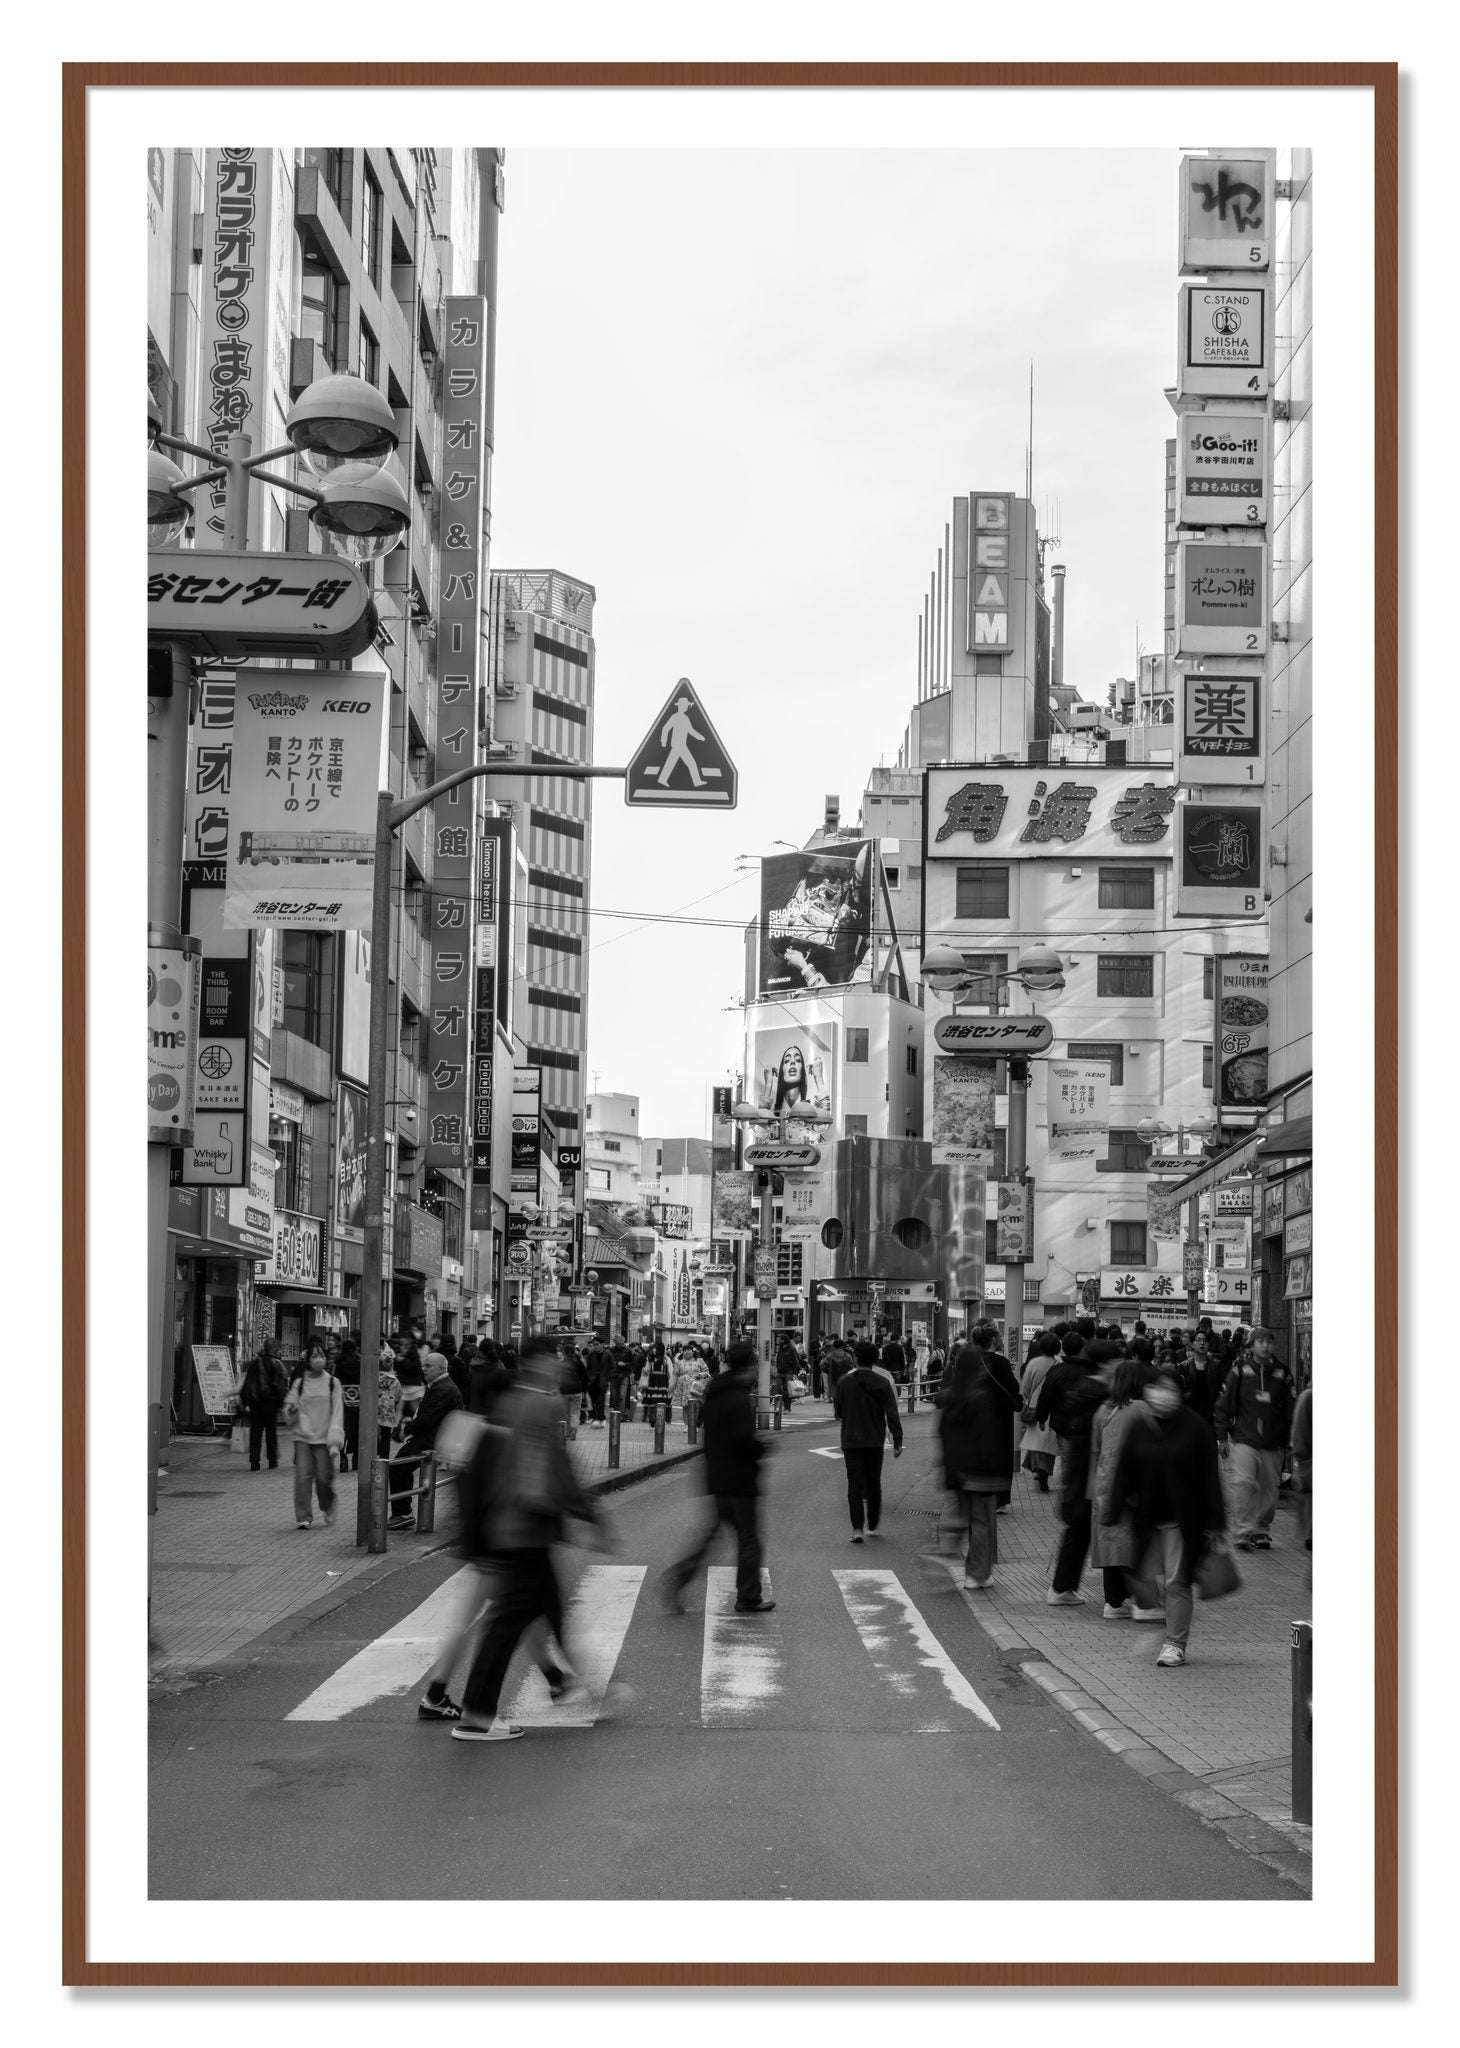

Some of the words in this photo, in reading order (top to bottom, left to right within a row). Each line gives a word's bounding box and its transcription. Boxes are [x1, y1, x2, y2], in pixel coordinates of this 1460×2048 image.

[215, 161, 256, 303] カラオケ
[1248, 247, 1262, 263] 5
[1203, 296, 1250, 306] C.STAND
[1203, 336, 1249, 348] SHISHA
[1203, 348, 1249, 357] CAFE&BAR
[1247, 376, 1260, 391] 4
[1202, 435, 1258, 453] Goo-it!
[1195, 455, 1255, 465] 渋谷宇田川町店
[1190, 481, 1259, 494] 全身もみほぐし
[1246, 504, 1259, 521] 3
[976, 498, 1010, 645] BEAM
[1191, 577, 1256, 597] ポムの樹
[1201, 600, 1248, 609] Pomme-no-ki
[1245, 634, 1258, 650] 2
[261, 708, 297, 716] KANTO
[322, 699, 372, 714] KEIO
[1194, 682, 1246, 735] 薬
[265, 736, 282, 781] 冒険へ
[284, 736, 303, 813] カントーの
[304, 736, 324, 813] ポケパーク
[326, 736, 345, 800] 京王線で
[1246, 764, 1254, 780] 1
[935, 782, 1177, 843] 角海老
[1188, 821, 1250, 871] 一蘭
[483, 842, 493, 878] kimono
[252, 901, 343, 915] 渋谷センター街
[1244, 894, 1256, 910] B
[1223, 975, 1269, 988] 四川料理
[206, 1007, 228, 1015] ROOM
[210, 1018, 224, 1026] BAR
[942, 1024, 1047, 1039] 渋谷センター街
[1221, 1033, 1251, 1054] 6F
[158, 1083, 178, 1098] Day!
[525, 1123, 537, 1132] UP
[194, 1149, 228, 1161] Whisky
[559, 1152, 580, 1164] GU
[193, 1159, 214, 1168] Bank
[1114, 1273, 1175, 1297] 兆楽
[680, 1273, 689, 1315] BEER
[677, 1317, 690, 1325] HALL
